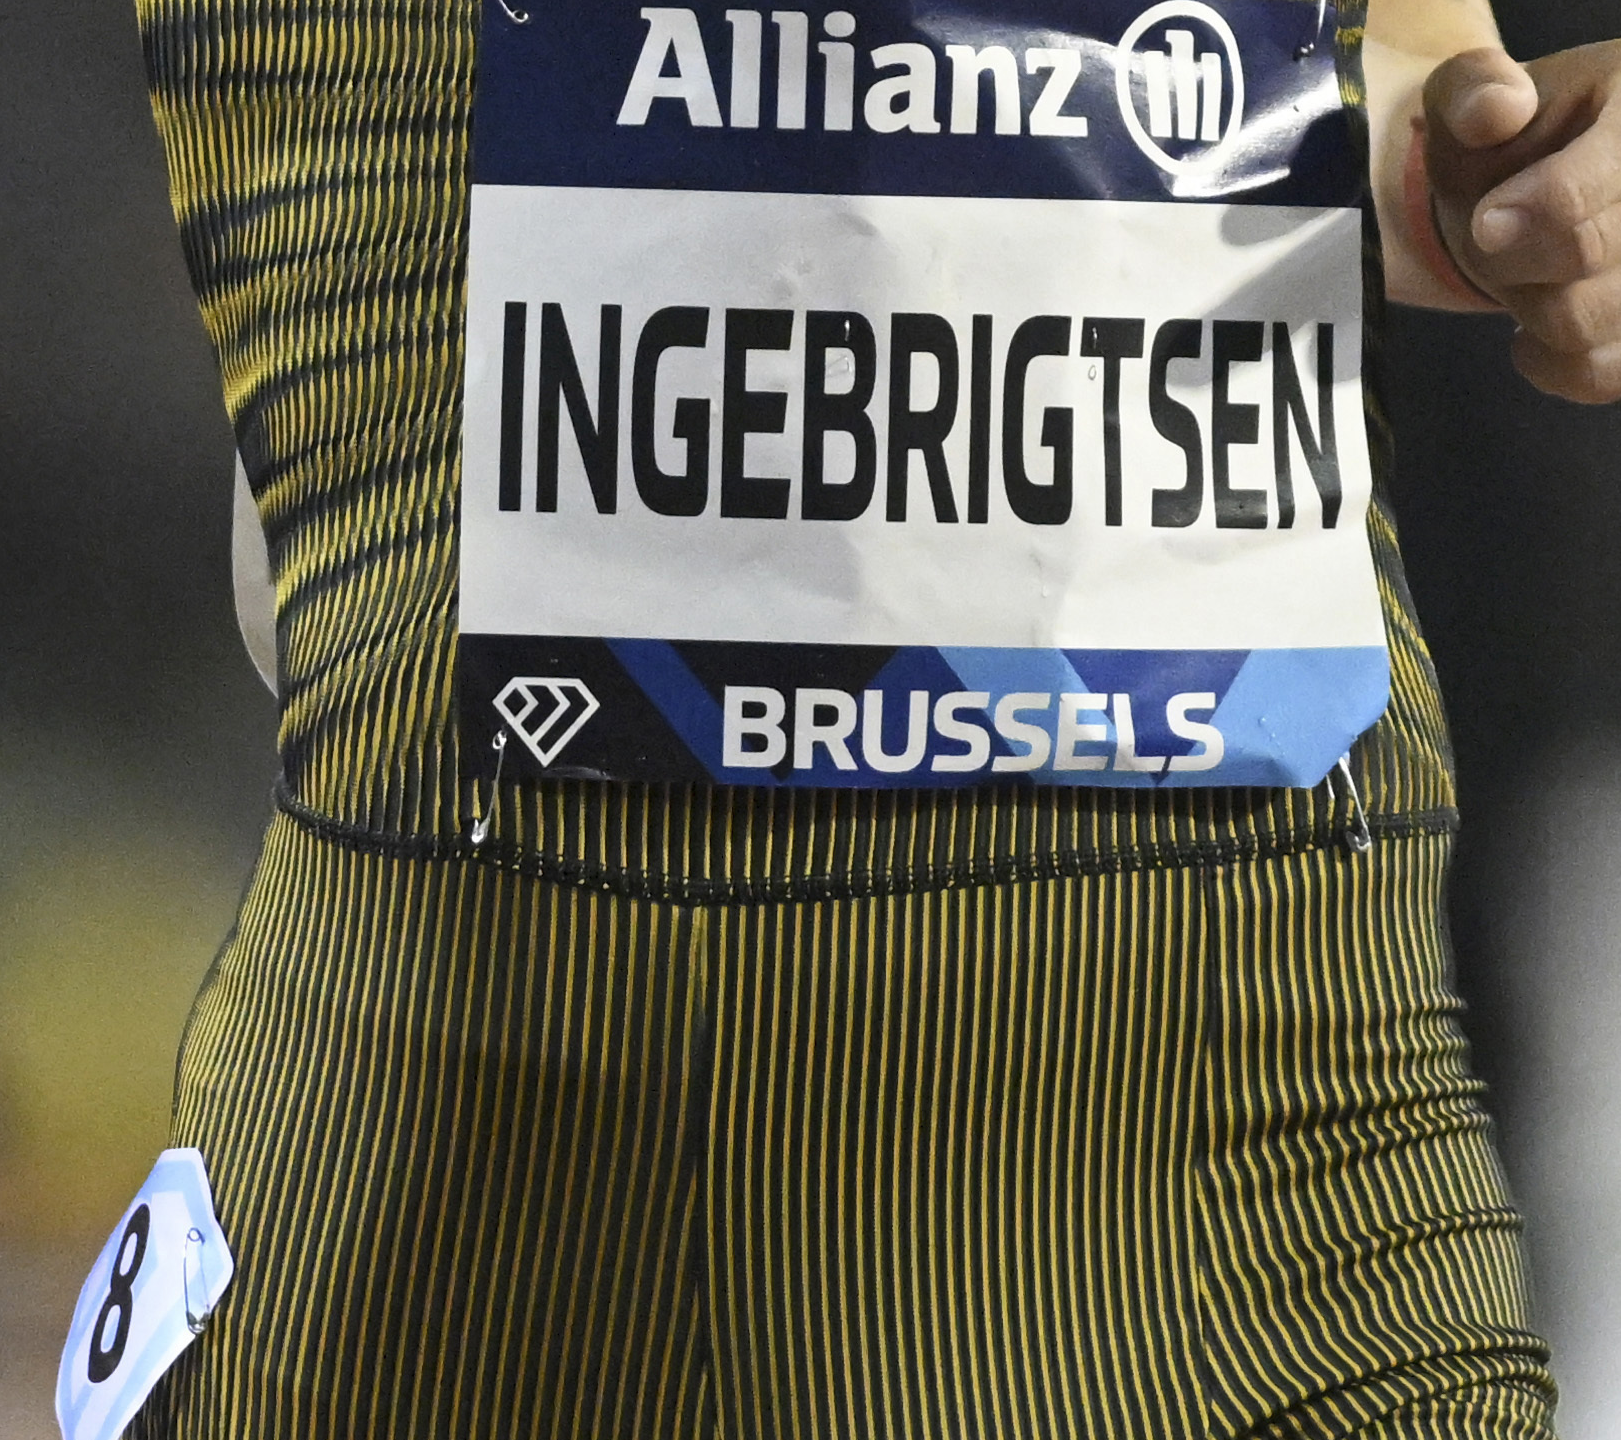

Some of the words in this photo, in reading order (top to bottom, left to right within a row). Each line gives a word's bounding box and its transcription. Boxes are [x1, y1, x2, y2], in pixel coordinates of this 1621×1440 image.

[615, 5, 1089, 138] Allianz
[497, 300, 1339, 531] INGEBRIGTSEN
[721, 684, 1225, 775] BRUSSELS
[87, 1202, 151, 1384] 8
